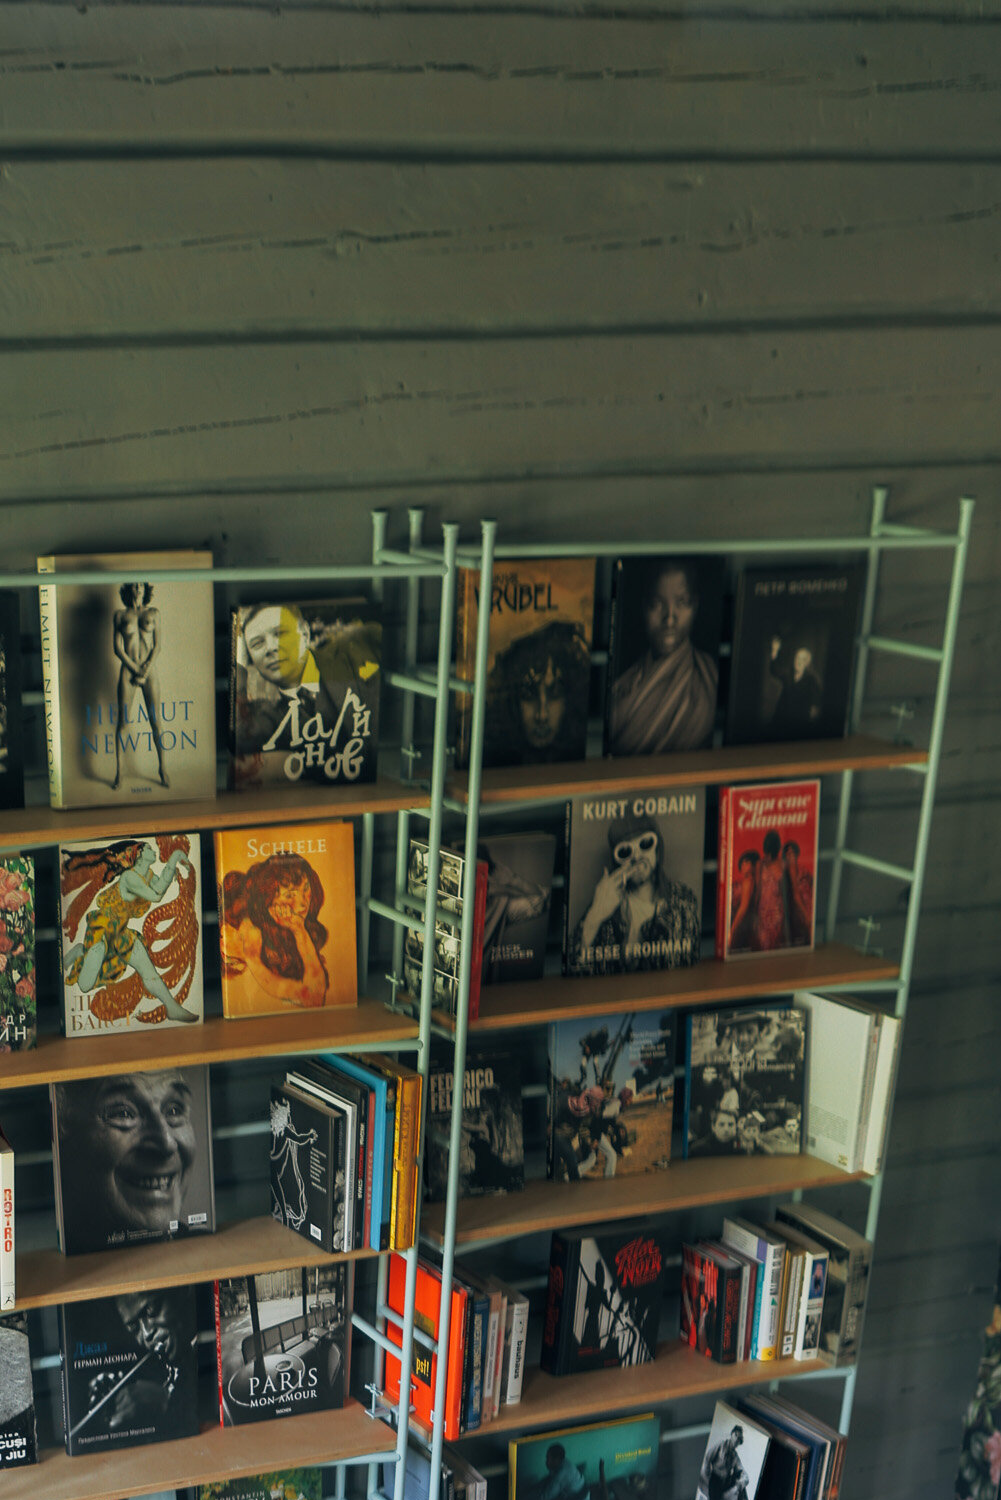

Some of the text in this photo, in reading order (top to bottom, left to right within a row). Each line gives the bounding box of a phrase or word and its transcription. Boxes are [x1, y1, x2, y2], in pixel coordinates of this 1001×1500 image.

[85, 701, 194, 726] HELMUT
[81, 730, 197, 755] NEWTON
[583, 794, 697, 821] KURT COBAIN
[247, 839, 327, 858] SCHIELE
[582, 938, 692, 963] JESSE FROHMAN
[74, 1341, 108, 1359] Джаз
[74, 1352, 137, 1369] ГЕРМАН ЛЕОНАРД
[514, 1340, 524, 1379] bauhaus
[416, 1357, 430, 1377] pst!
[249, 1367, 318, 1396] PARIS
[250, 1389, 317, 1408] MON AMOUR
[5, 1449, 26, 1461] JIU
